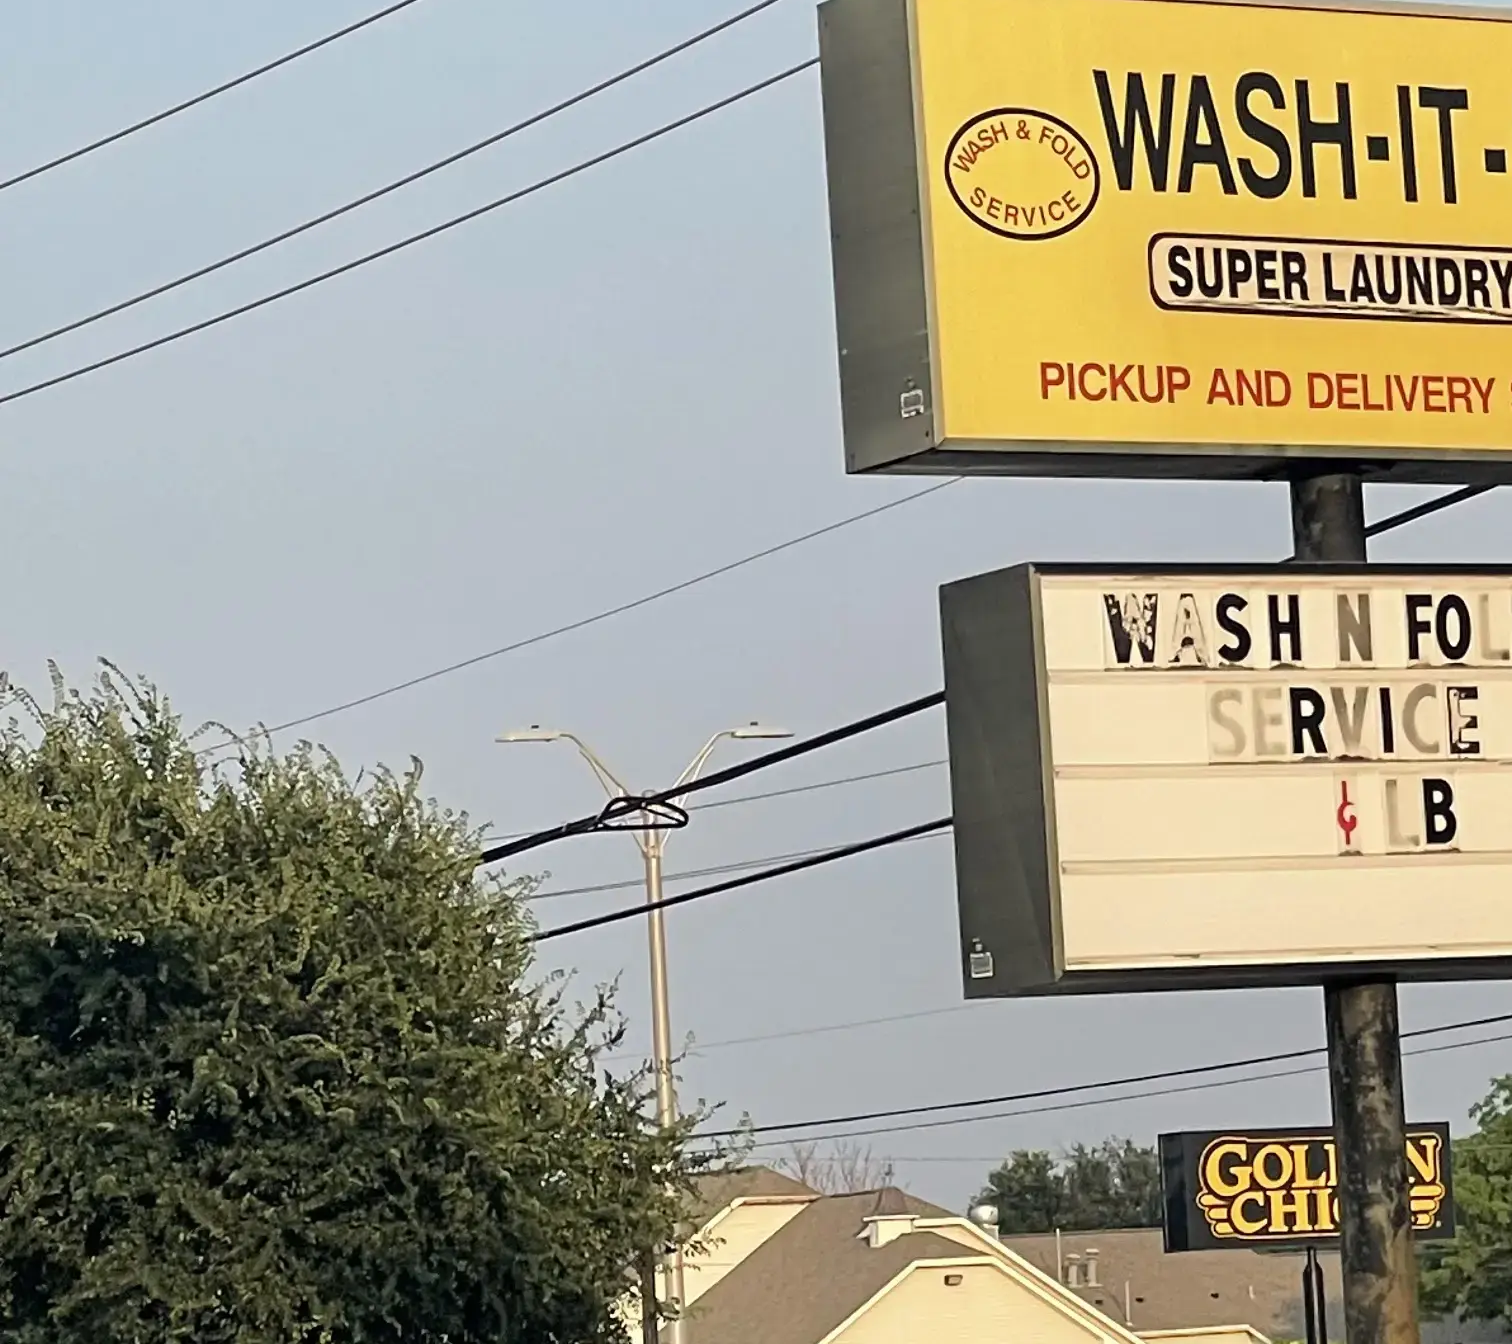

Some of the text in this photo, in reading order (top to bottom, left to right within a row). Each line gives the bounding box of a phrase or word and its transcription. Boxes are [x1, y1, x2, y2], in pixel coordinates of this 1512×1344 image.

[953, 119, 1090, 179] WASH & FOLD
[970, 187, 1081, 227] SERVICE
[1167, 244, 1309, 301] SUPER
[1039, 361, 1191, 404] PICKUP
[1206, 368, 1291, 407] AND
[1307, 372, 1495, 414] DELIVERY
[1103, 592, 1302, 667] WASH
[1336, 593, 1373, 661] N
[1209, 683, 1481, 756] SERVICE
[1385, 777, 1457, 846] LB
[1205, 1137, 1438, 1197] GOLN
[1230, 1189, 1341, 1235] CHI
